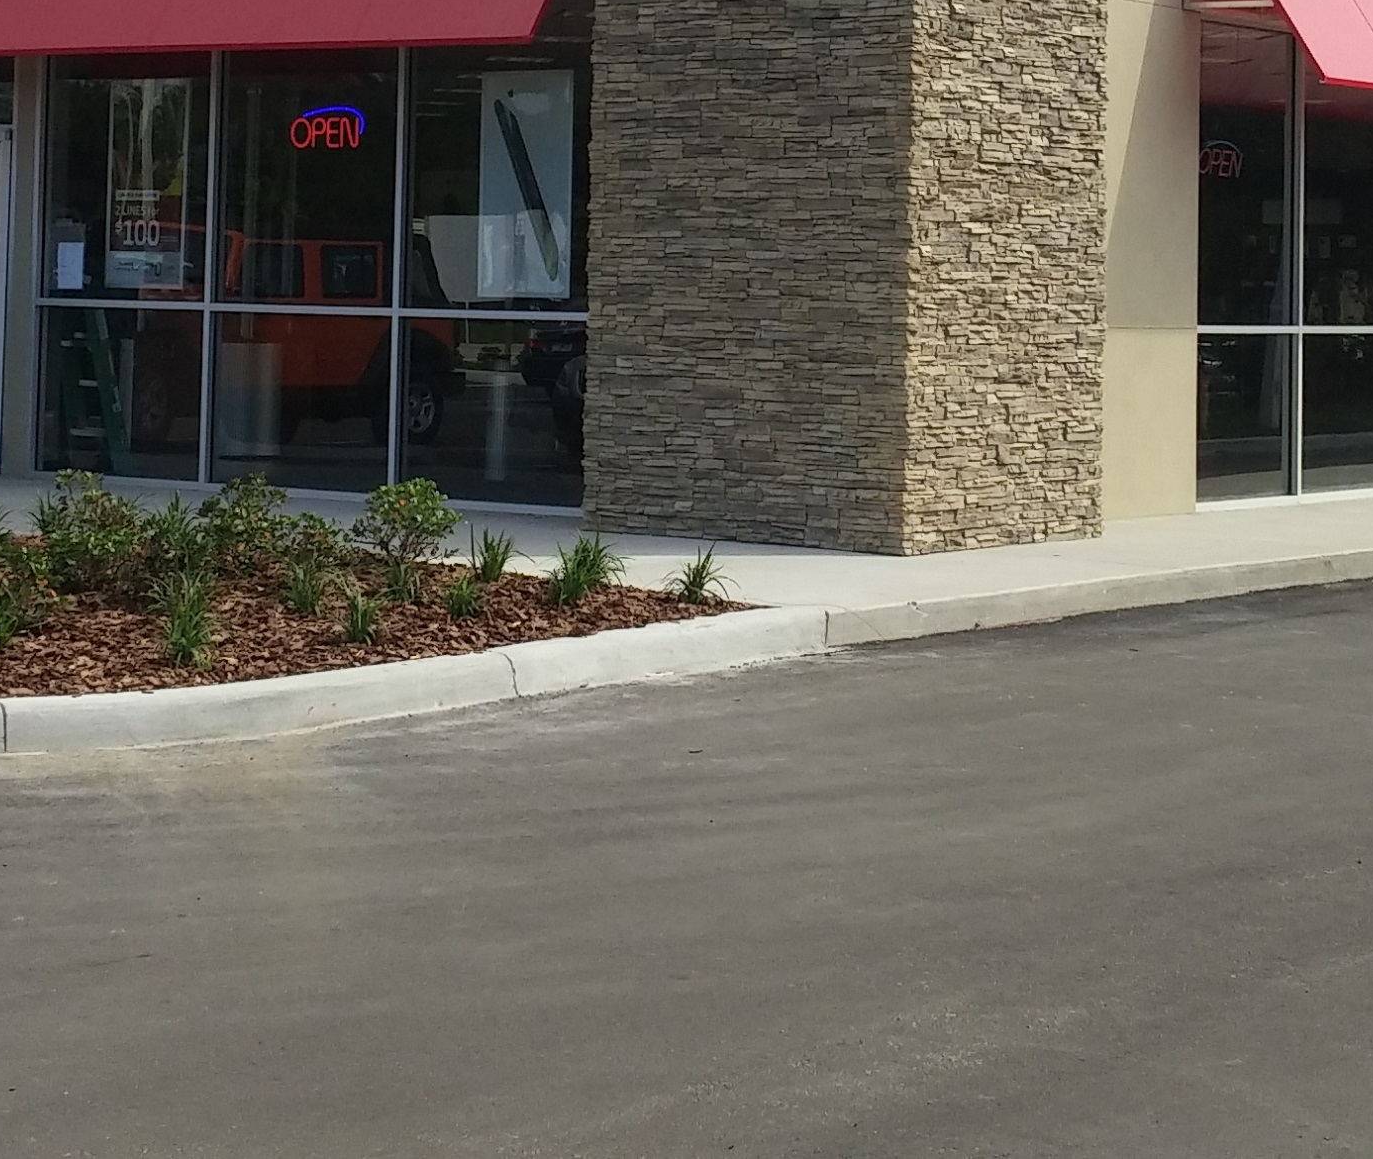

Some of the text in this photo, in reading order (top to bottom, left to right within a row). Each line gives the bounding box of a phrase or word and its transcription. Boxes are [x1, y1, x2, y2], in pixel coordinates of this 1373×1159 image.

[290, 117, 360, 148] OPEN
[1199, 148, 1244, 178] OPEN
[115, 218, 160, 247] $100
